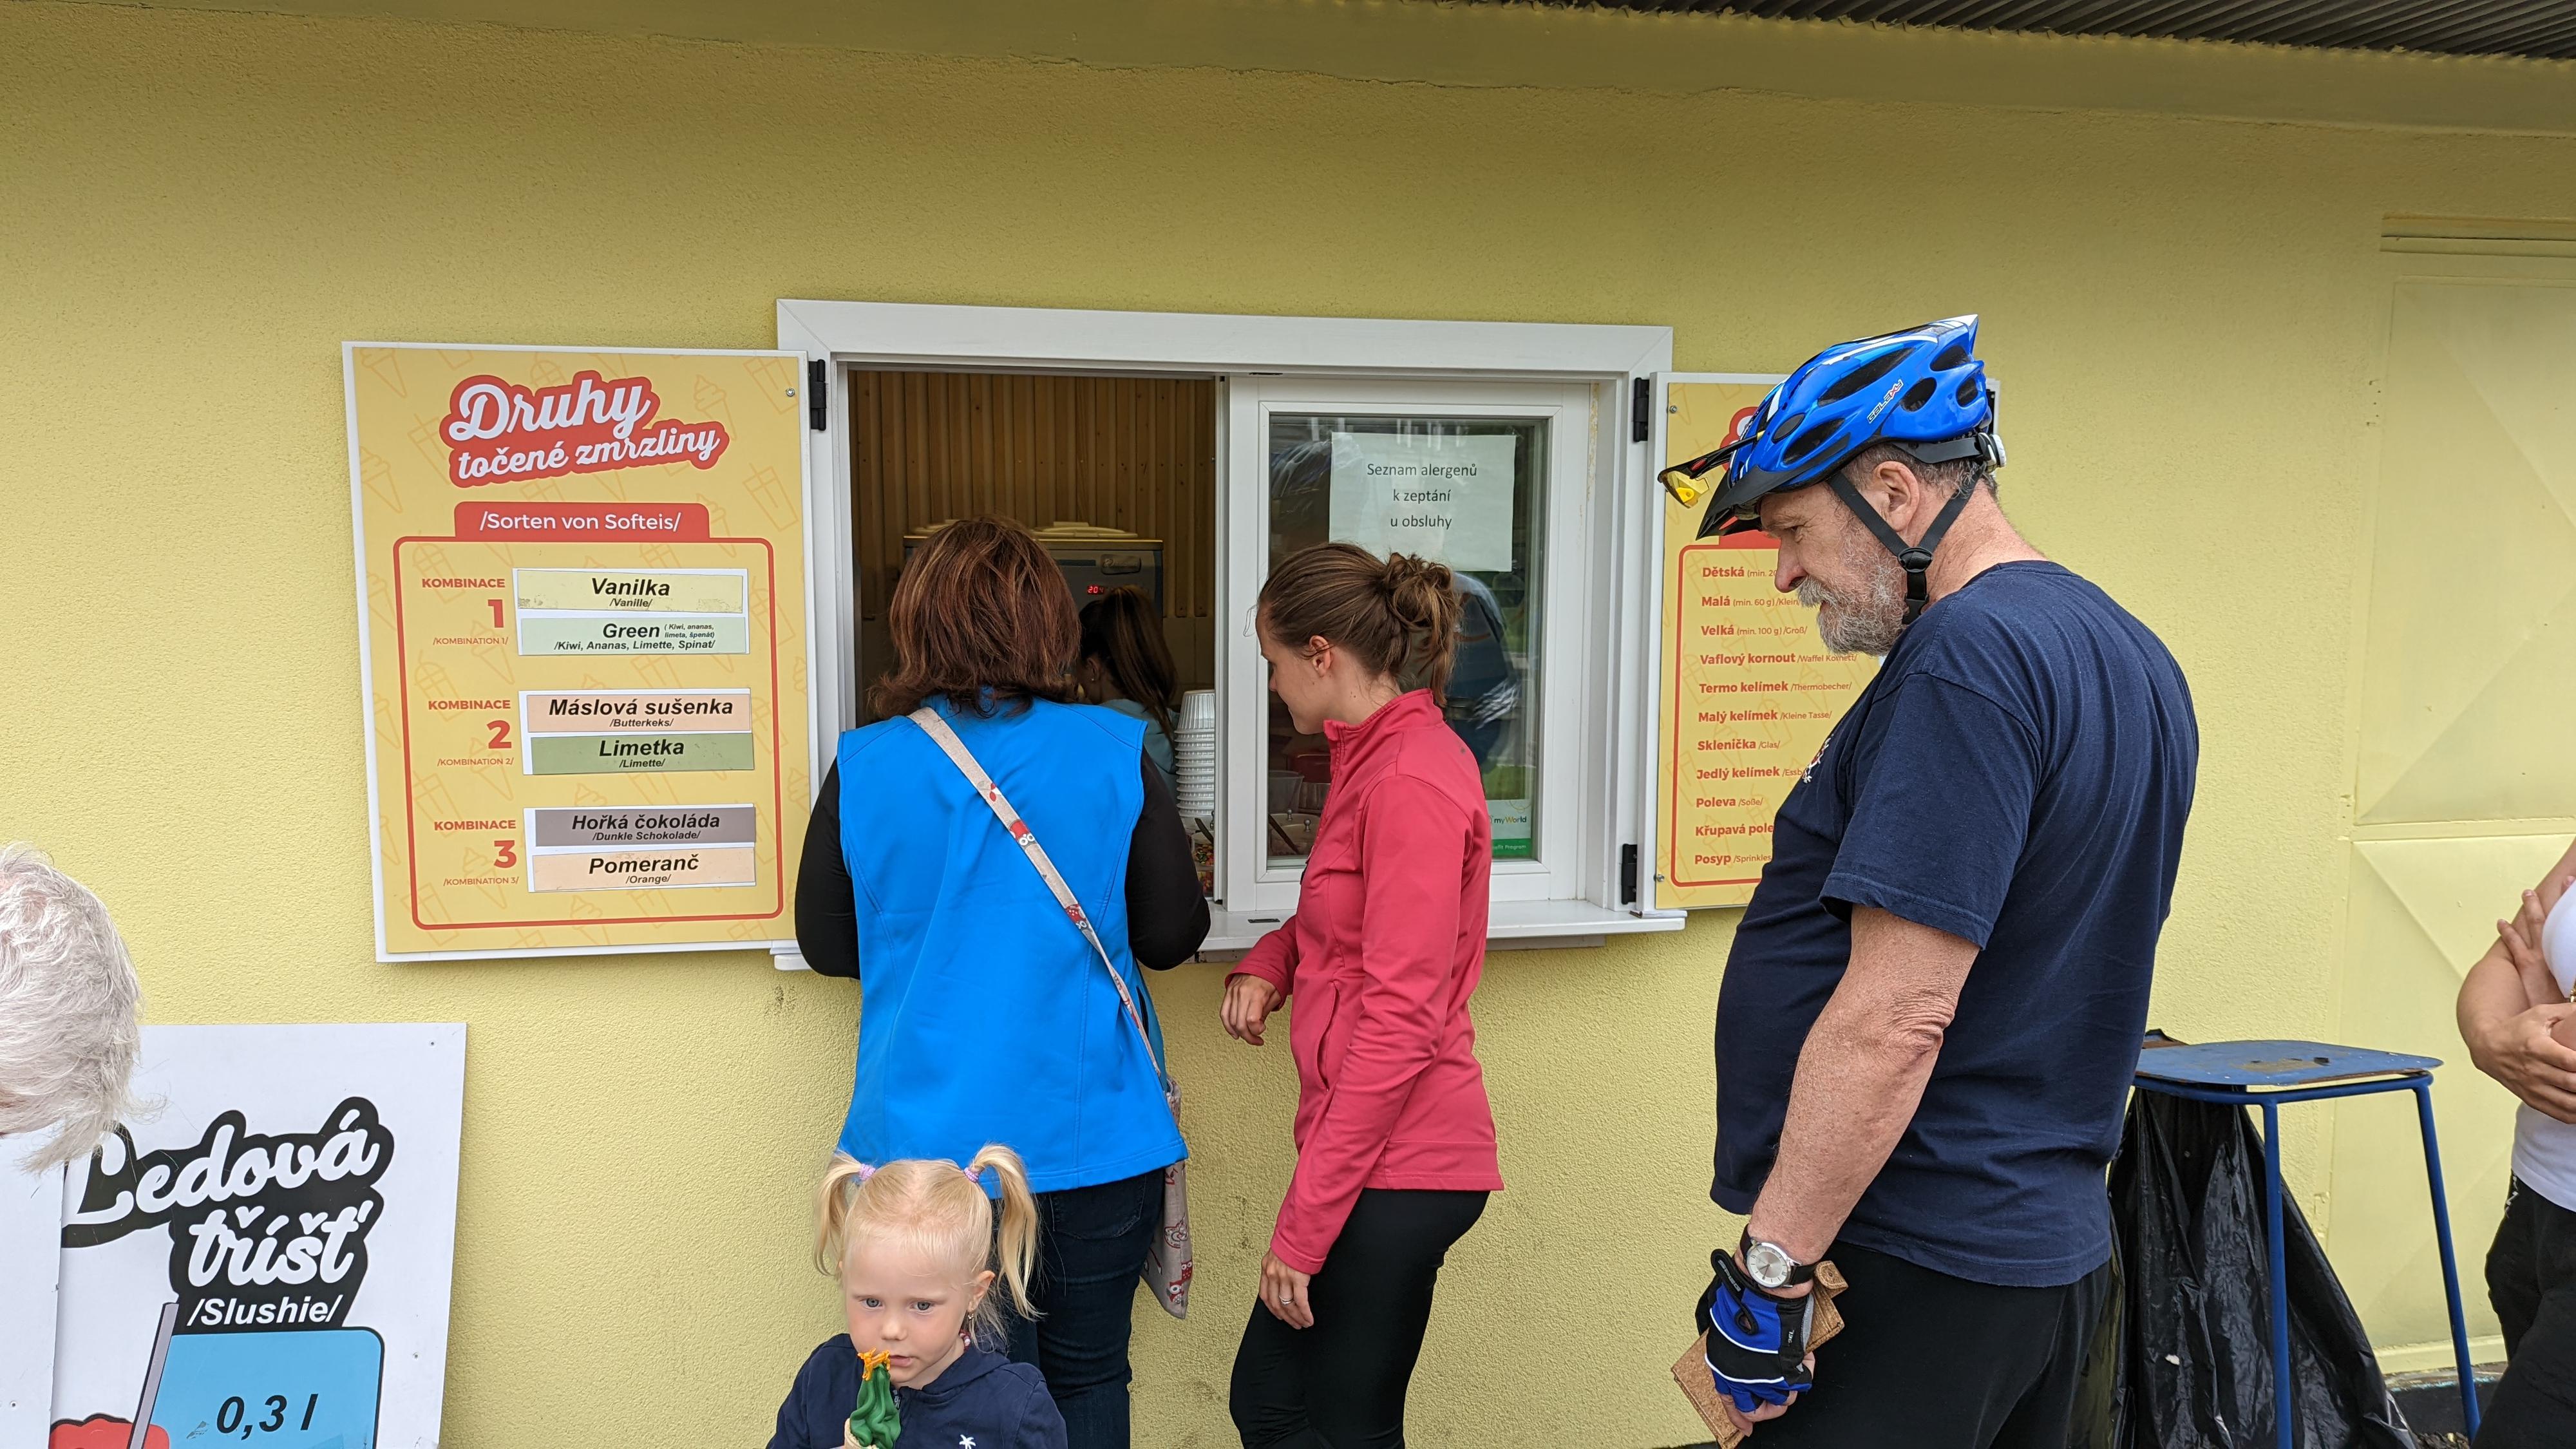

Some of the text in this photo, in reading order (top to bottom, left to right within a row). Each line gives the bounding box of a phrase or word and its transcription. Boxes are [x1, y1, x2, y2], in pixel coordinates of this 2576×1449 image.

[450, 379, 650, 440] Druhy
[459, 427, 720, 478] točené zmrzliny
[1367, 462, 1477, 479] Seznam alergenů
[1393, 489, 1451, 504] k zeptání
[480, 513, 681, 533] /Sorten von Softeis/
[1390, 516, 1452, 529] u obsluhy
[1703, 567, 1744, 578] Dětská
[422, 578, 506, 588] KOMBINACE
[591, 578, 670, 596] Vanilka
[610, 598, 652, 608] /Vanille/
[1701, 596, 1730, 607] Malá
[488, 600, 504, 628] 1
[603, 623, 660, 639] Green
[1701, 625, 1734, 636] Velká
[1774, 627, 1782, 636] g)
[1783, 626, 1808, 634] /Groß/
[433, 637, 498, 645] /KOMBINATION
[554, 640, 715, 651] /Kiwi, Ananas, Limette, Spinat/
[1700, 653, 1745, 666] Vaflový
[1748, 653, 1795, 663] kornout
[1700, 681, 1852, 693] Termo kelímek /Thermobecher/
[428, 700, 511, 710] KOMBINACE
[549, 697, 734, 716] Máslová sušenka
[610, 718, 674, 728] /Butterkeks/
[1698, 709, 1832, 724] Malý kelímek /Kleine Tasse/
[487, 720, 512, 749] 2
[600, 739, 685, 757] Limetka
[1698, 739, 1780, 750] Sklenička /Glas/
[437, 757, 514, 766] /KOMBINATION 2/
[620, 759, 665, 768] /Limette/
[1697, 766, 1803, 781] Jedlý kelímek /Essb
[1696, 797, 1763, 808] Poleva /Soße/
[434, 820, 516, 831] KOMBINACE
[572, 813, 720, 831] Hořká čokoláda
[592, 831, 701, 841] /Dunkle Schokolade/
[1696, 823, 1774, 837] Křupavá pole
[493, 840, 516, 868] 3
[1695, 855, 1772, 866] Posyp /Sprinkles
[589, 854, 699, 875] Pomeranč
[444, 877, 519, 887] /KOMBINATION 3/
[626, 874, 671, 884] /Orange/
[62, 1110, 379, 1226] Ledová
[189, 1200, 373, 1287] tříšť
[187, 1294, 342, 1326] /Slushie/
[216, 1394, 285, 1441] 0,3
